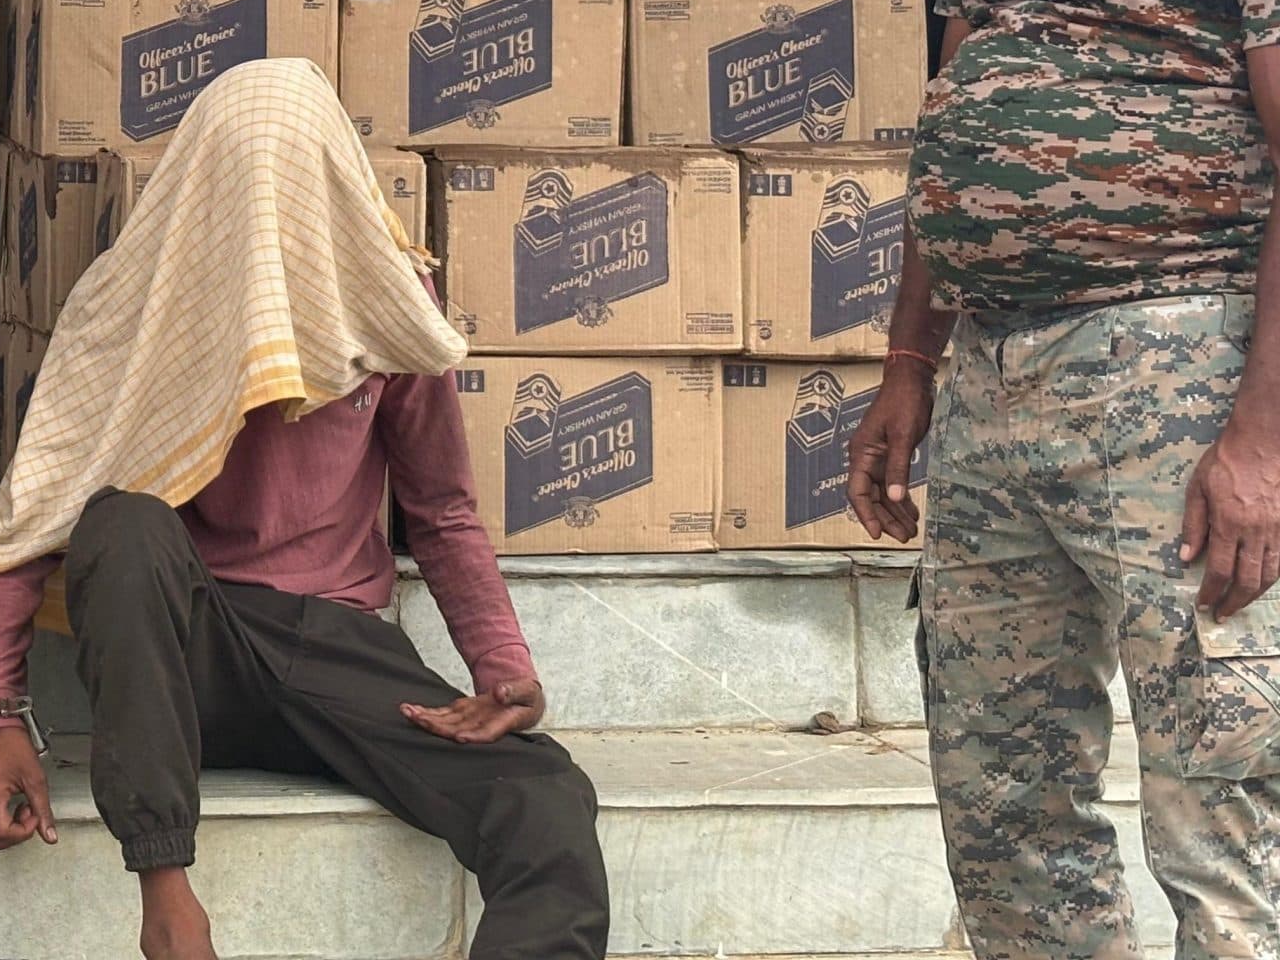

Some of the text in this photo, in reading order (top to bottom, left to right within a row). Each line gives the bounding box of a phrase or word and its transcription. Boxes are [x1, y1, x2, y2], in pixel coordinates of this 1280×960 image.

[140, 26, 236, 69] Officer's Choice
[463, 27, 534, 76] BLUE
[726, 33, 823, 79] Officer's Choice
[140, 50, 215, 98] BLUE
[440, 57, 535, 99] Officer's Choice
[728, 58, 801, 108] BLUE
[570, 219, 648, 270] BLUE
[549, 249, 649, 295] Officer's Choice
[844, 278, 888, 302] Choice
[560, 419, 634, 471] BLUE
[537, 449, 636, 496] Officer's Choice
